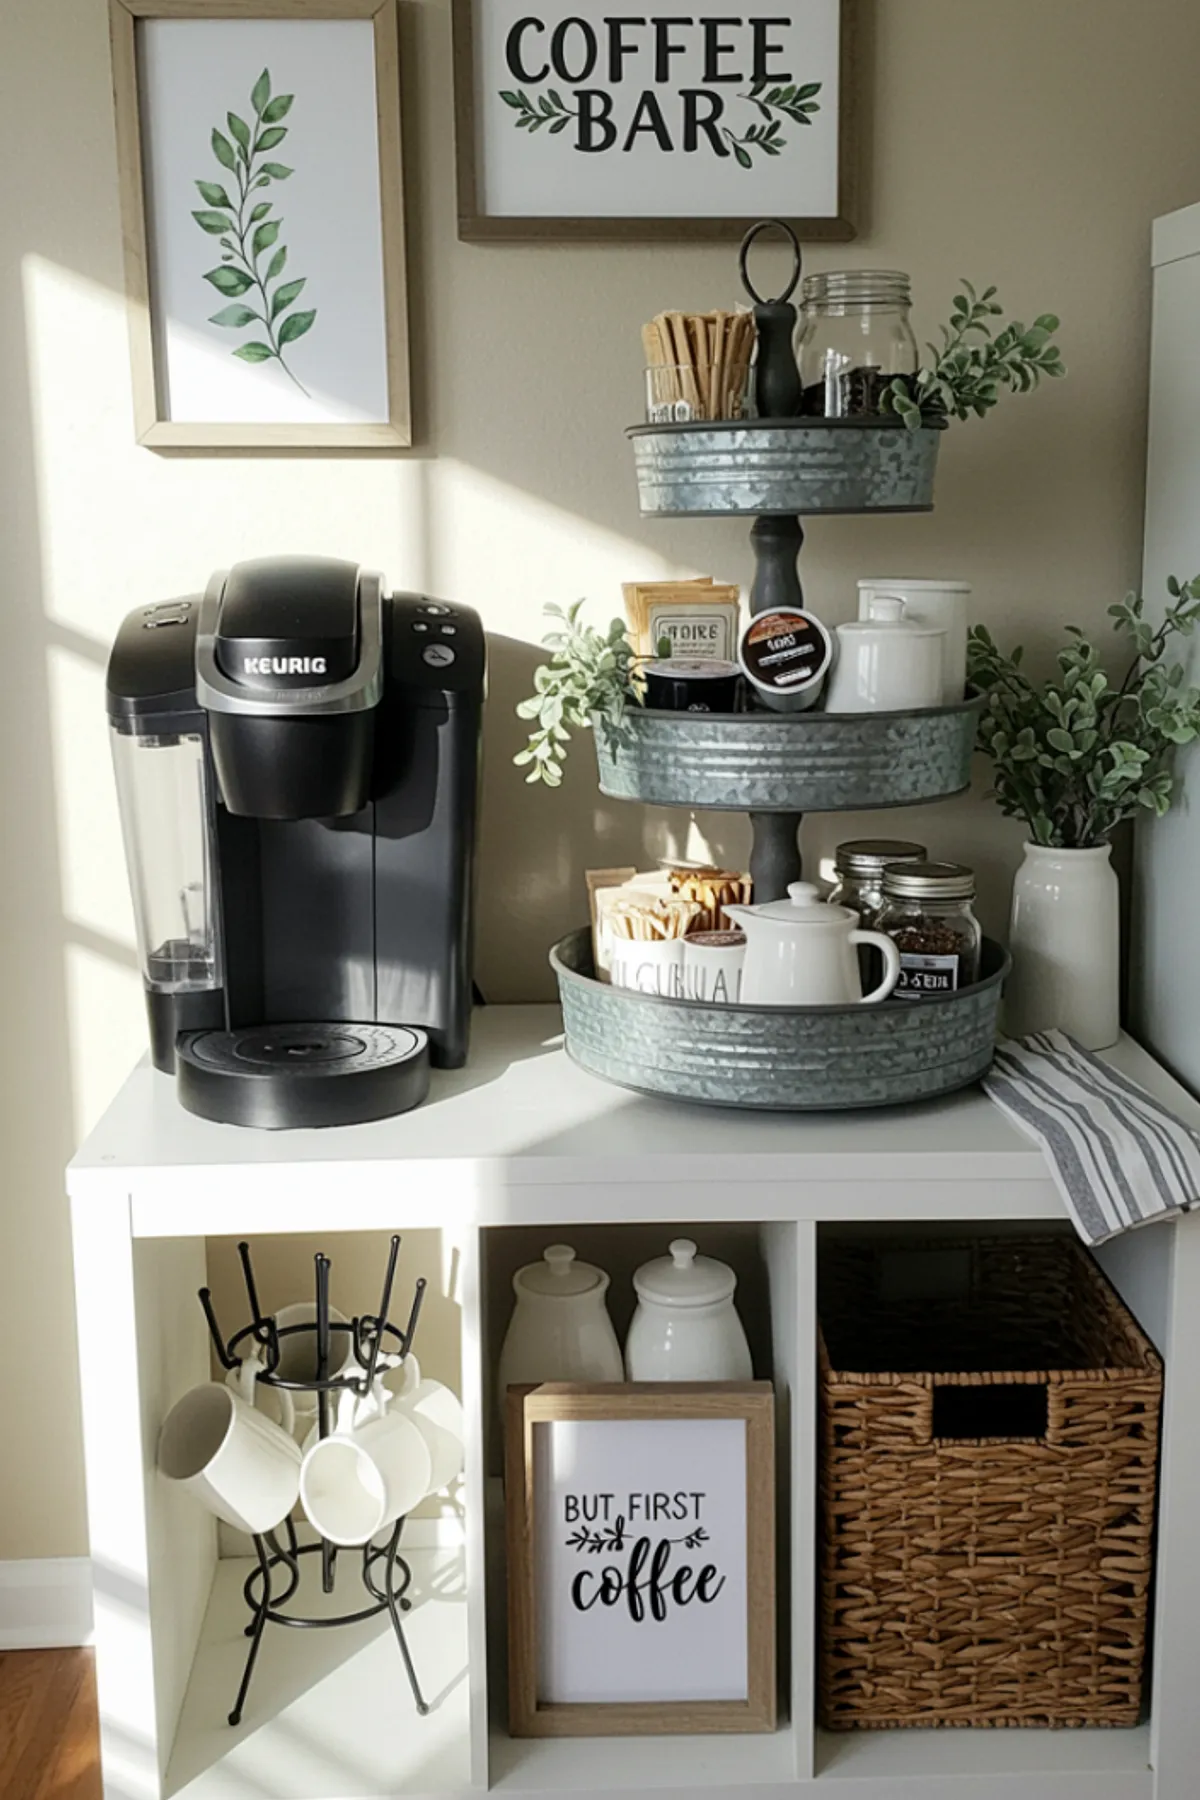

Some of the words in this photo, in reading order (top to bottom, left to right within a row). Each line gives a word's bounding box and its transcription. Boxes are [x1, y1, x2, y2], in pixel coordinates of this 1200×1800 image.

[505, 16, 793, 84] COFFEE
[572, 89, 731, 157] BAR
[243, 656, 327, 674] KEURIG
[564, 1493, 615, 1523] BUT
[628, 1491, 706, 1521] FIRST
[571, 1536, 727, 1623] coffee
